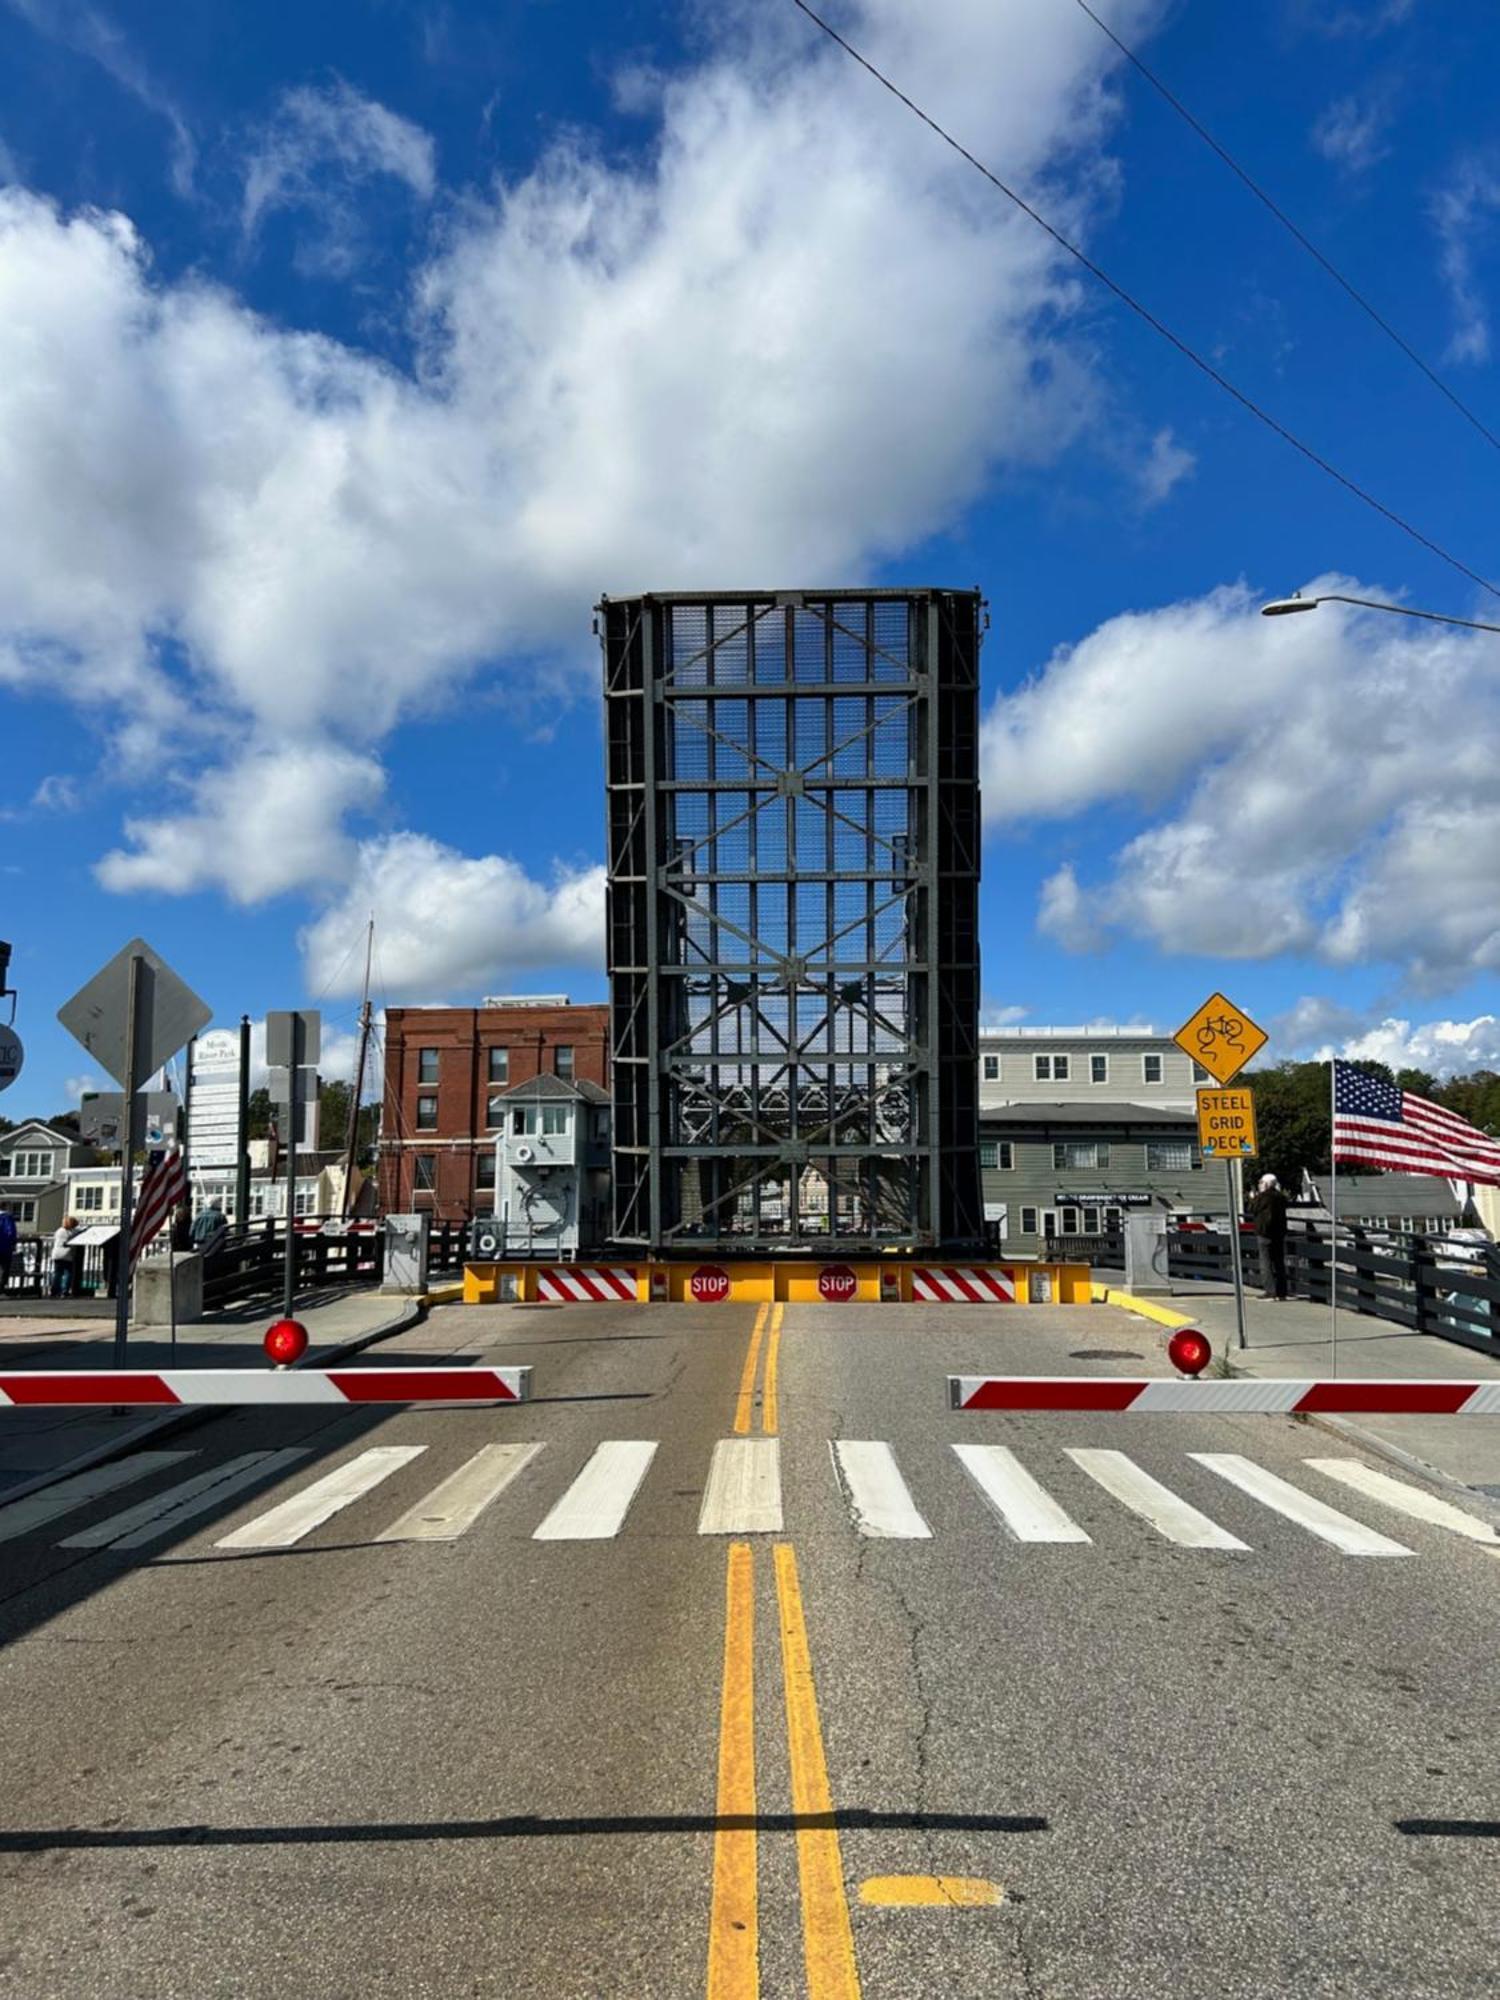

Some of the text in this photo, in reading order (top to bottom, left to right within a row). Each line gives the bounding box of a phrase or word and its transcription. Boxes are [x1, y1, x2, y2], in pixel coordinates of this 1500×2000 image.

[1201, 1096, 1250, 1111] STEEL
[1209, 1115, 1244, 1130] GRID
[1207, 1135, 1249, 1150] DECK
[692, 1276, 728, 1292] STOP
[820, 1276, 854, 1292] STOP
